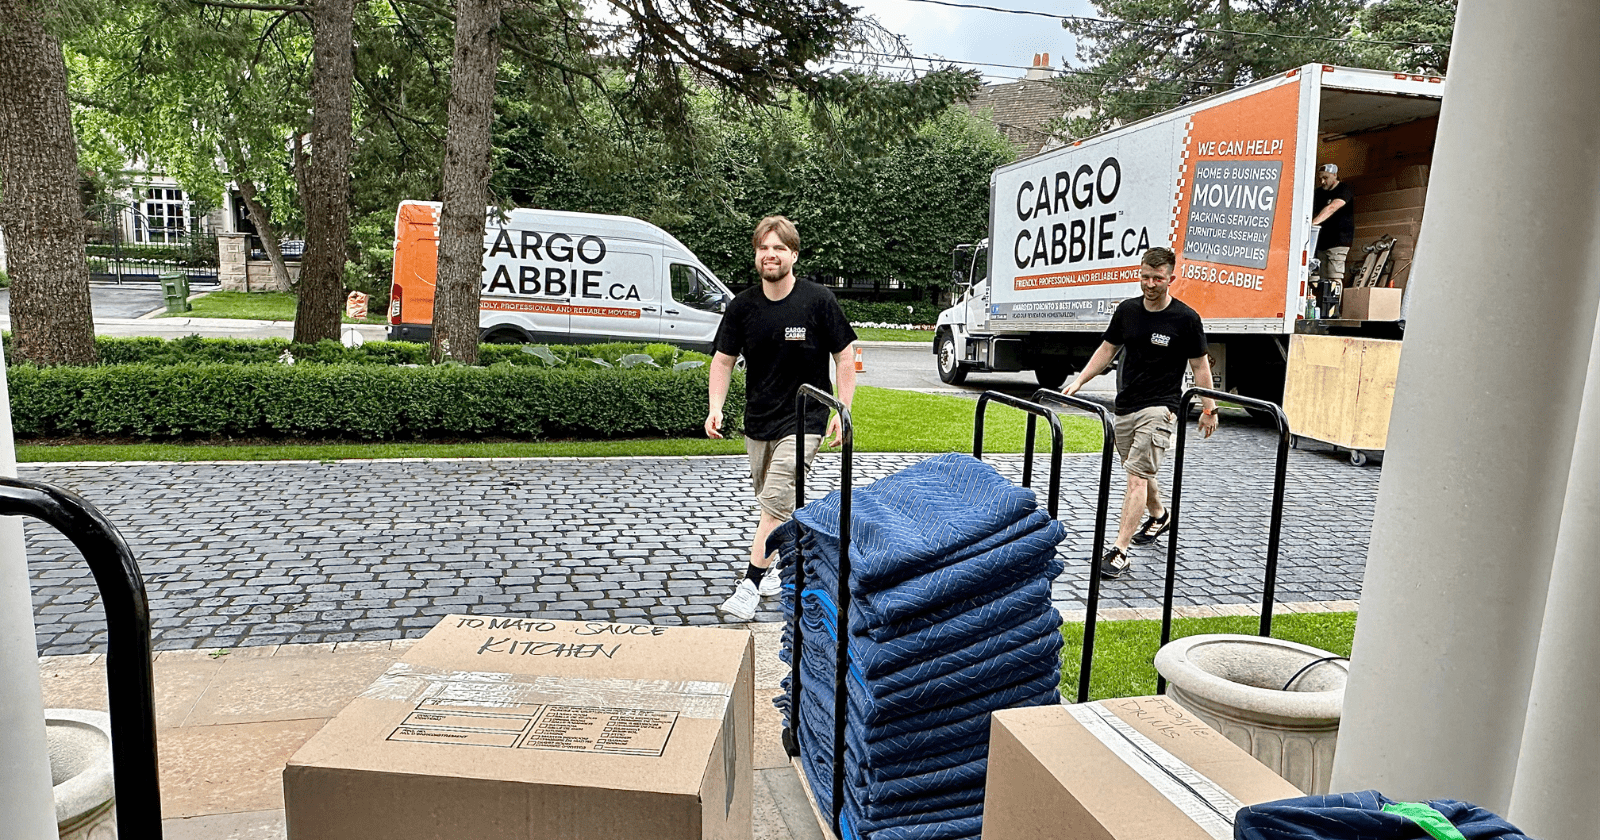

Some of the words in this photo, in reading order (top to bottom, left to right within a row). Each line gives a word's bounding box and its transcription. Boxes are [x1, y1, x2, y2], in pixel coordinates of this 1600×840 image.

[1198, 141, 1216, 156] WE
[1218, 140, 1244, 156] CAN
[1246, 139, 1284, 155] HELP!
[1196, 168, 1222, 179] HOME
[1223, 168, 1230, 179] &
[1231, 168, 1278, 180] BUSINESS
[1016, 156, 1121, 222] CARGO
[1192, 183, 1274, 211] MOVING
[1190, 211, 1226, 224] PACKING
[1227, 213, 1270, 228] SERVICES
[1188, 226, 1227, 239] FURNITURE
[1228, 229, 1267, 243] ASSEMBLY
[482, 228, 607, 264] ARGO
[1186, 241, 1220, 255] MOVING
[1221, 245, 1266, 260] SUPPLIES
[481, 264, 641, 301] ABBIE.CA
[1038, 275, 1077, 286] PROFESSIONAL
[1077, 274, 1090, 283] AND
[1091, 270, 1118, 281] RELIABLE
[500, 303, 555, 312] PROFESSIONAL
[575, 622, 669, 636] SAUCE
[477, 636, 622, 659] KITCHEN
